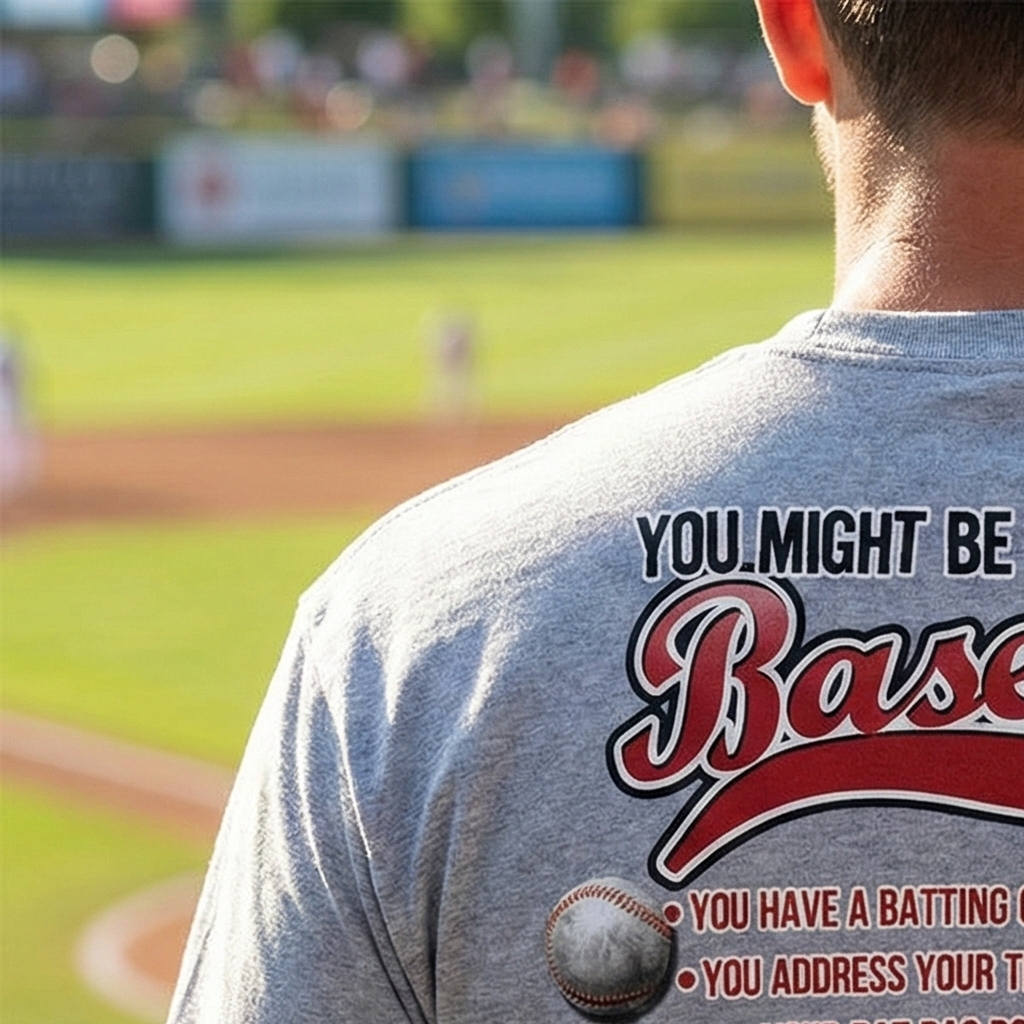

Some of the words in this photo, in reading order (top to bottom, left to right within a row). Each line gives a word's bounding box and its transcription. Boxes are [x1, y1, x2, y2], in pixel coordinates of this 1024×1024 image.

[636, 509, 744, 582] YOU
[757, 509, 928, 576] MIGHT
[946, 510, 1013, 576] BE
[689, 891, 750, 931] YOU
[759, 889, 838, 929] HAVE
[848, 889, 869, 926] A
[878, 886, 1009, 927] BATTING
[702, 958, 762, 998] YOU
[771, 954, 907, 996] ADDRESS
[916, 952, 995, 992] YOUR
